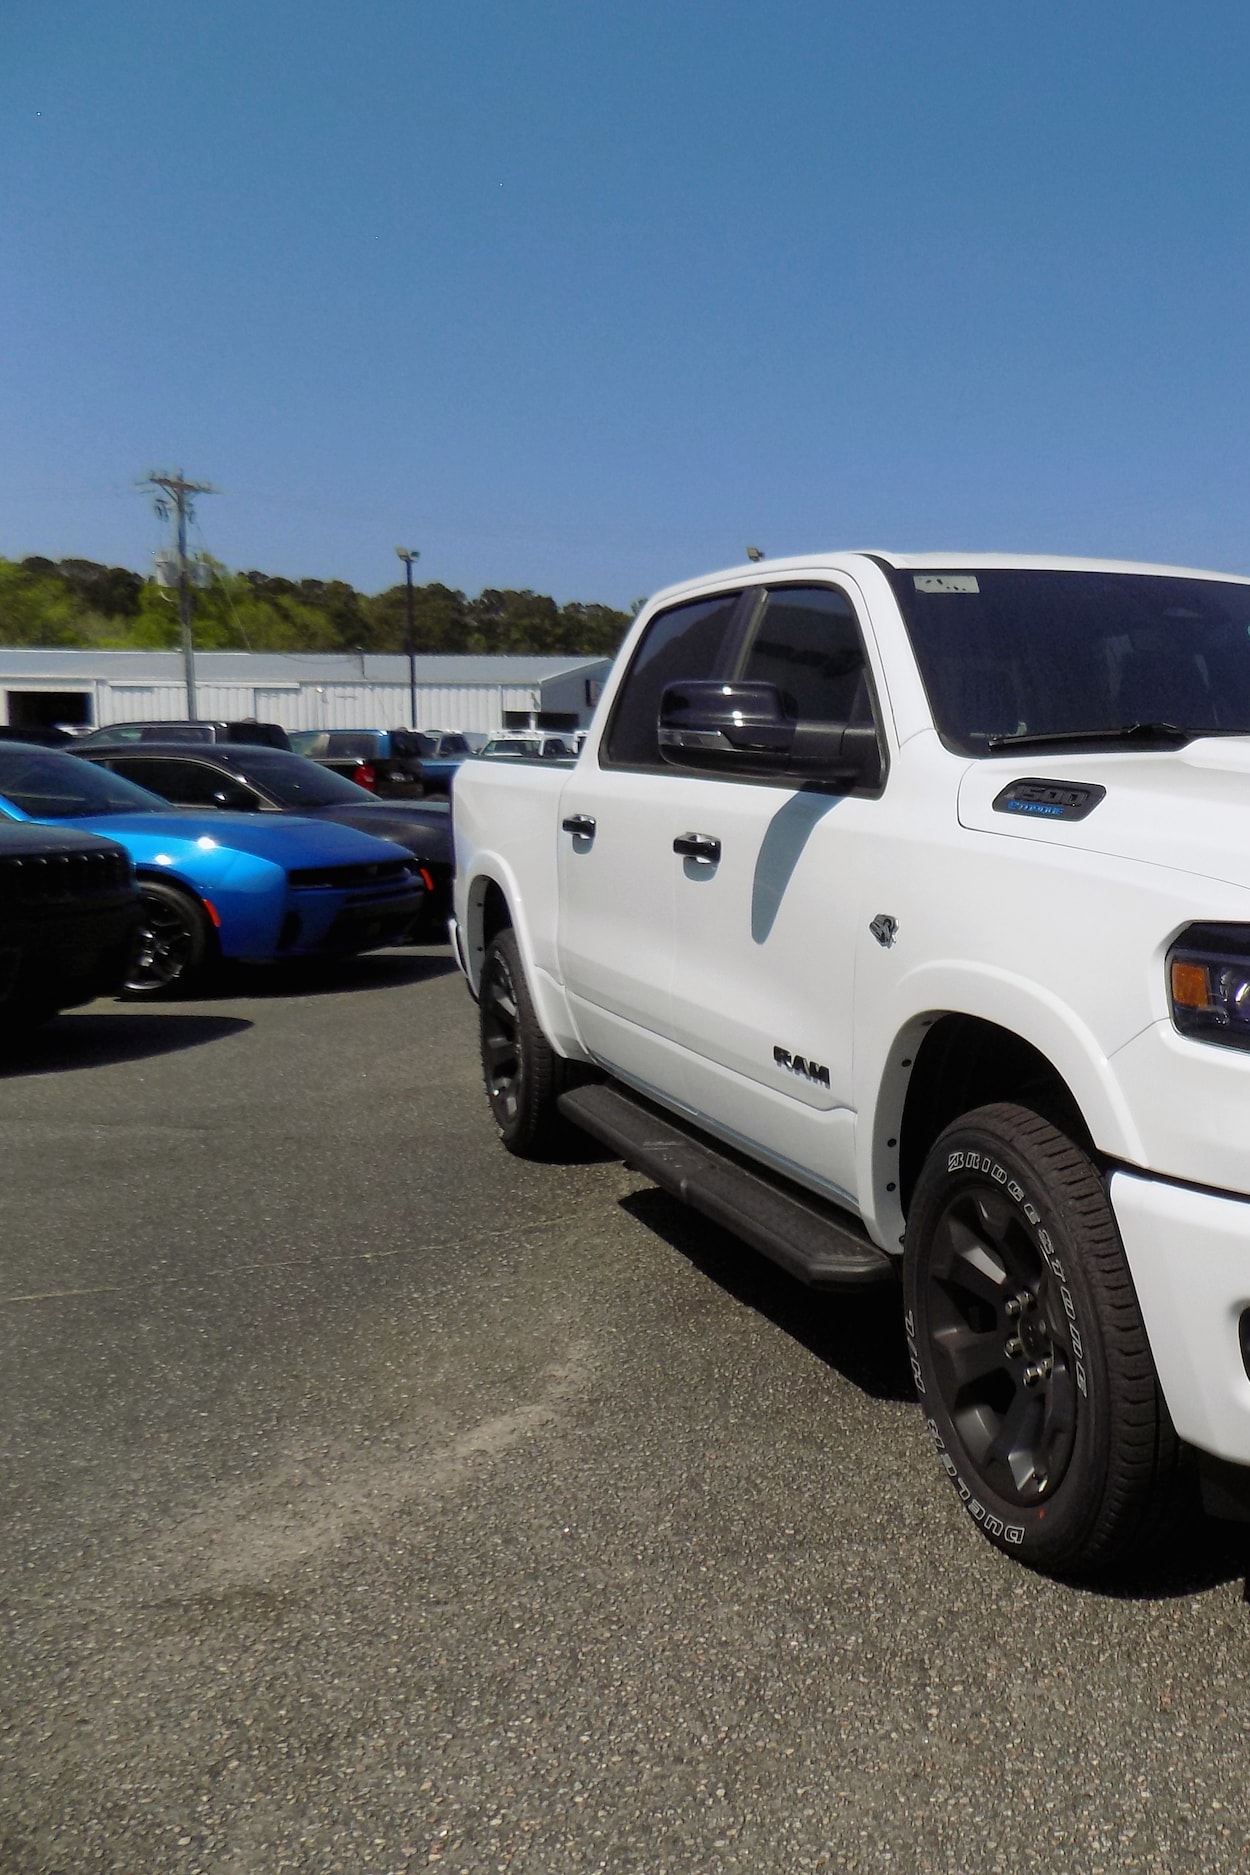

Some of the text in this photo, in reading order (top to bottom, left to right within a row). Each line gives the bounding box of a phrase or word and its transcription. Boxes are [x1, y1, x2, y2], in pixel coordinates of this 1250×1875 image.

[773, 1045, 831, 1089] RAM
[948, 1152, 1088, 1398] BRIDGESTONE
[927, 1417, 1025, 1545] DUELER
